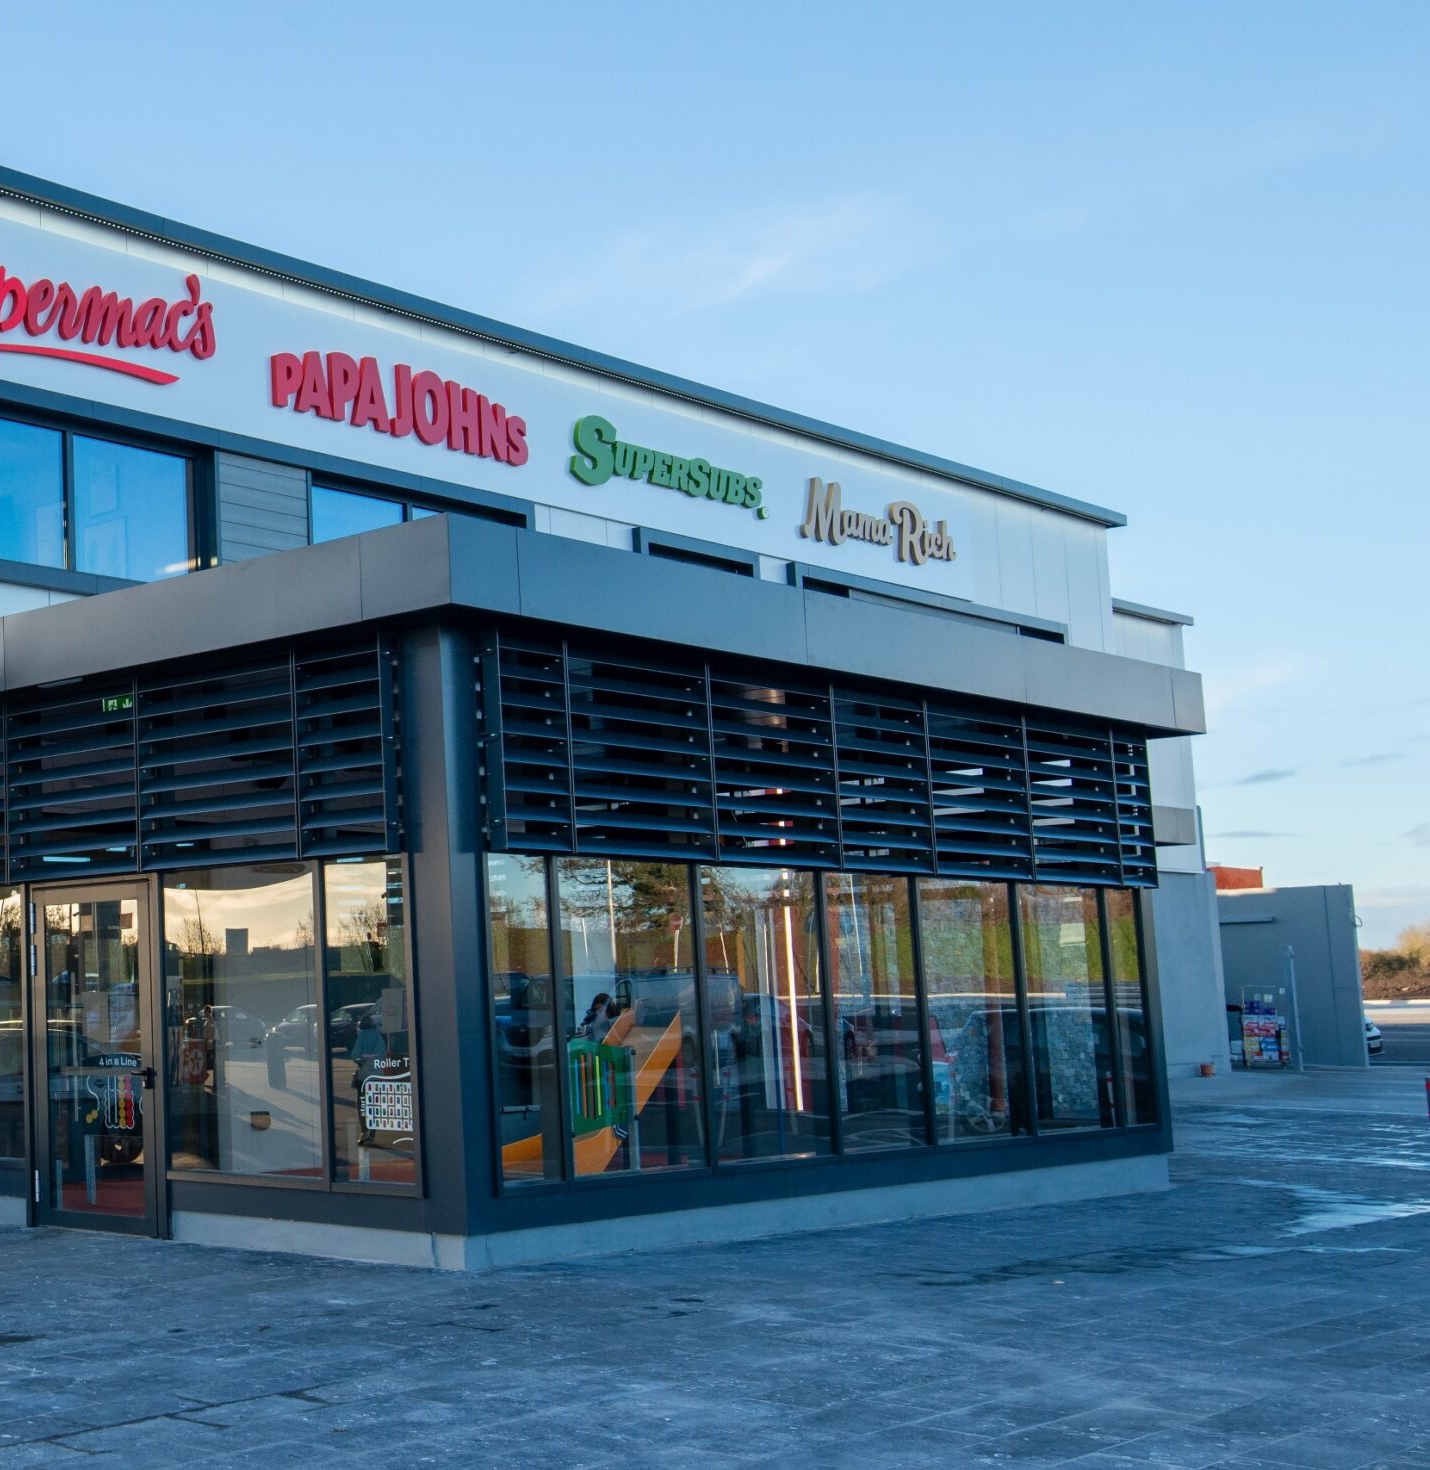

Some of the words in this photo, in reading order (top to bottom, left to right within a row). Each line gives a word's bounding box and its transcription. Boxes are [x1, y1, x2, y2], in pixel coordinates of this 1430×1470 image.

[800, 476, 893, 546] Mama
[889, 500, 957, 566] Rich
[99, 1057, 105, 1067] 4
[120, 1056, 137, 1067] Line
[373, 1058, 402, 1069] Roller
